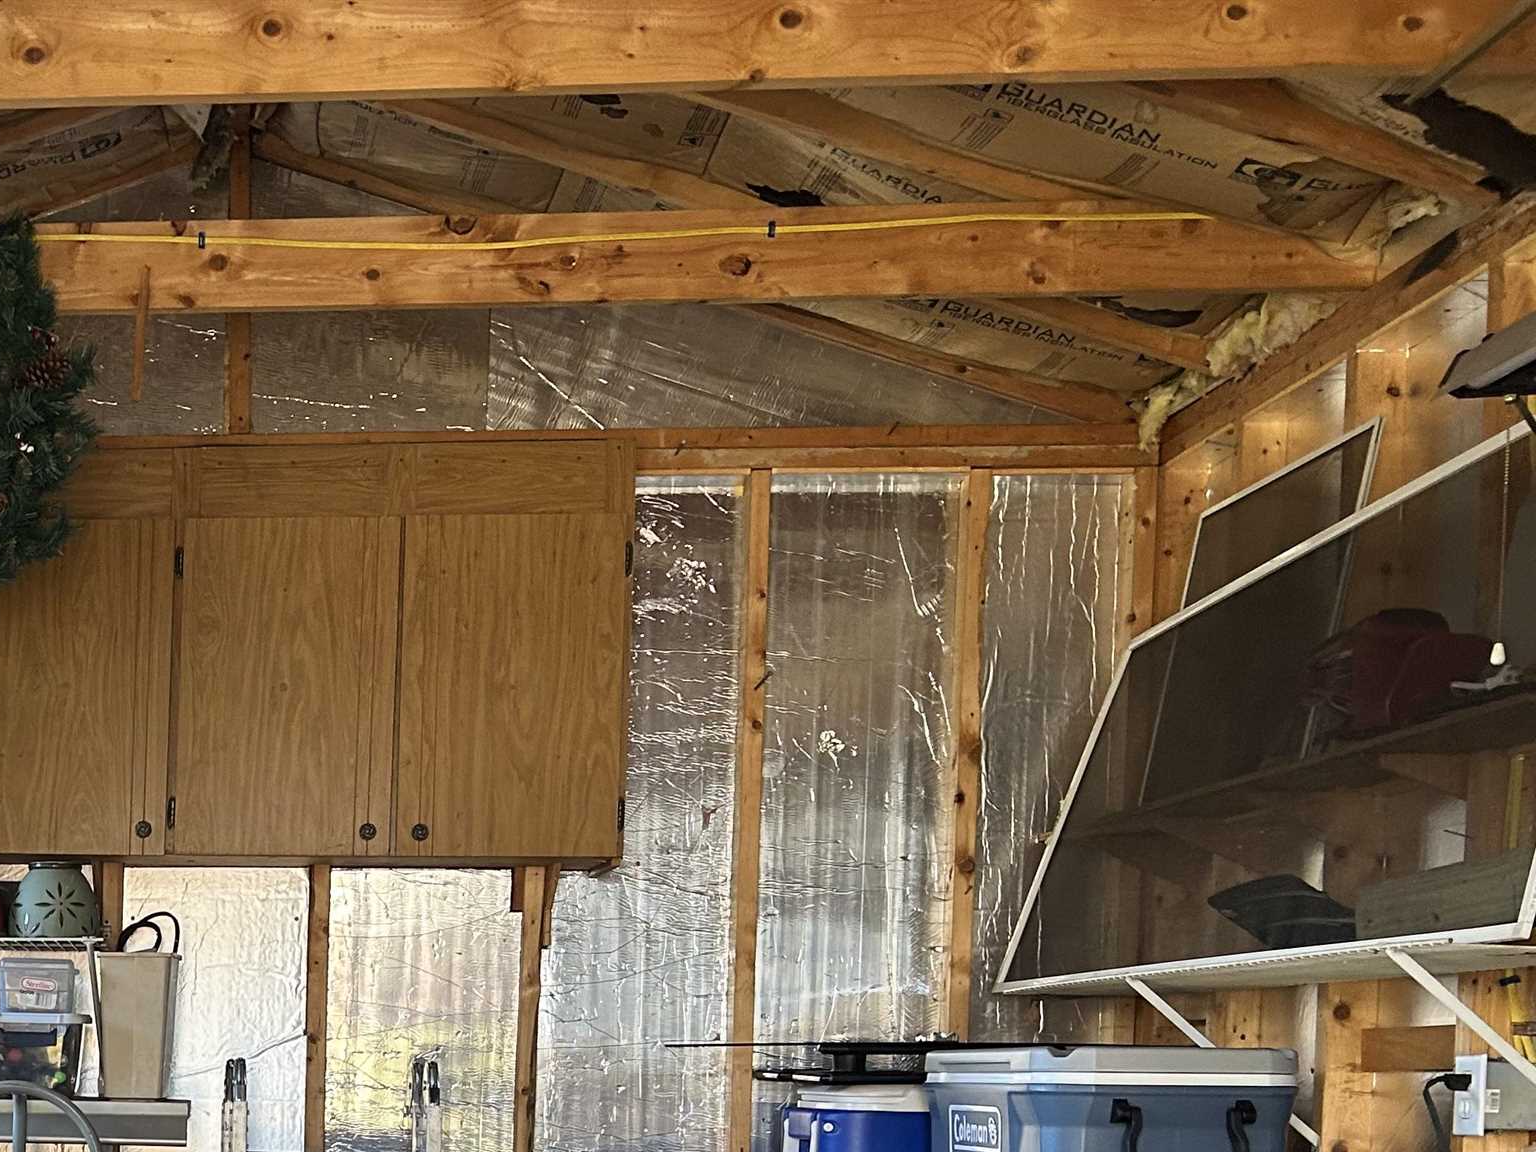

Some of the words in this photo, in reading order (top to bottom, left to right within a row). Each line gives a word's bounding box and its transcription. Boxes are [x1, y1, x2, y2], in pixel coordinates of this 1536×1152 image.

[996, 93, 1108, 135] FIBERGLASS
[1111, 130, 1219, 170] INSULATION
[1002, 83, 1162, 143] GUARDIAN
[939, 300, 1076, 344] GUARDIAN
[954, 1113, 988, 1143] Coleman
